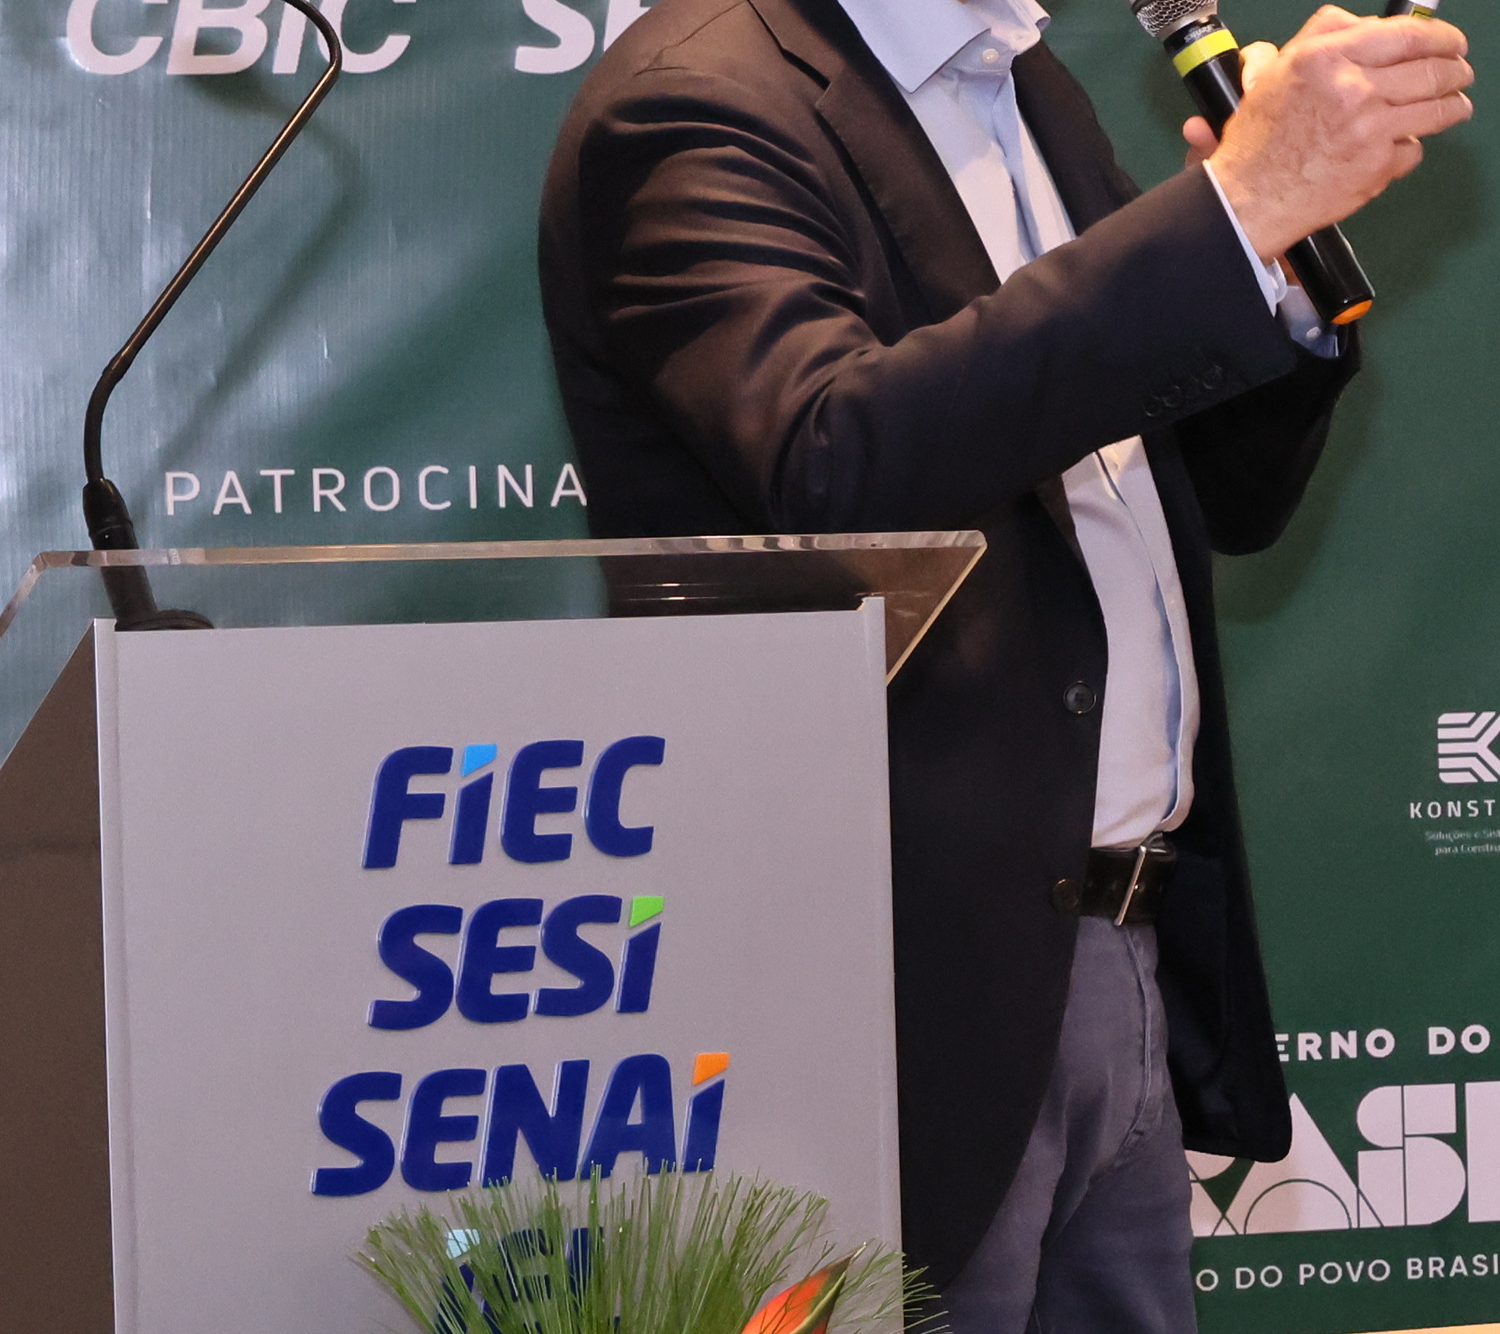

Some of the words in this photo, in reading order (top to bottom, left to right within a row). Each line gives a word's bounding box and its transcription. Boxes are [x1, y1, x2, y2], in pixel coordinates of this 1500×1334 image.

[163, 463, 588, 518] PATROCINA
[1434, 846, 1459, 856] para
[1428, 1024, 1491, 1055] DO
[1235, 1265, 1283, 1290] DO
[1299, 1259, 1391, 1286] POVO
